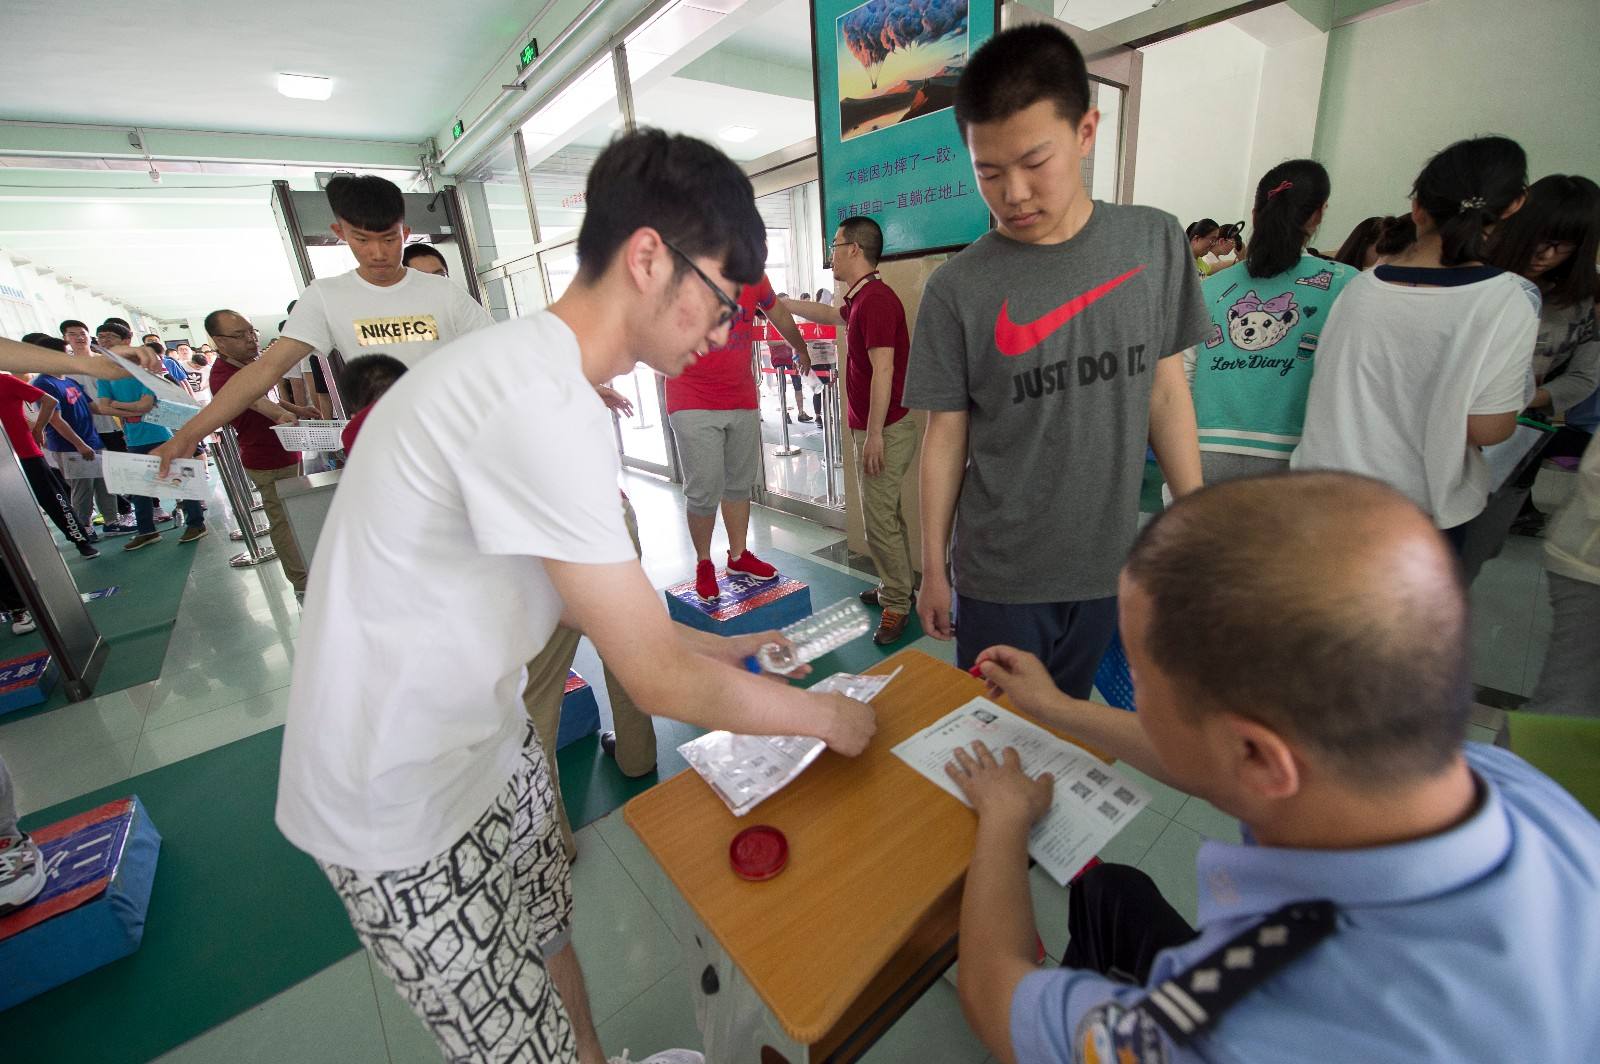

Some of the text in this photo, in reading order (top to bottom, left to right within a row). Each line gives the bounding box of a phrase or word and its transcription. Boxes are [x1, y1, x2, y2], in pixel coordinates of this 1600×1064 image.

[360, 320, 433, 339] NIKE F.C.
[1012, 344, 1146, 405] JUST DO IT.
[1210, 353, 1295, 377] Love Diary
